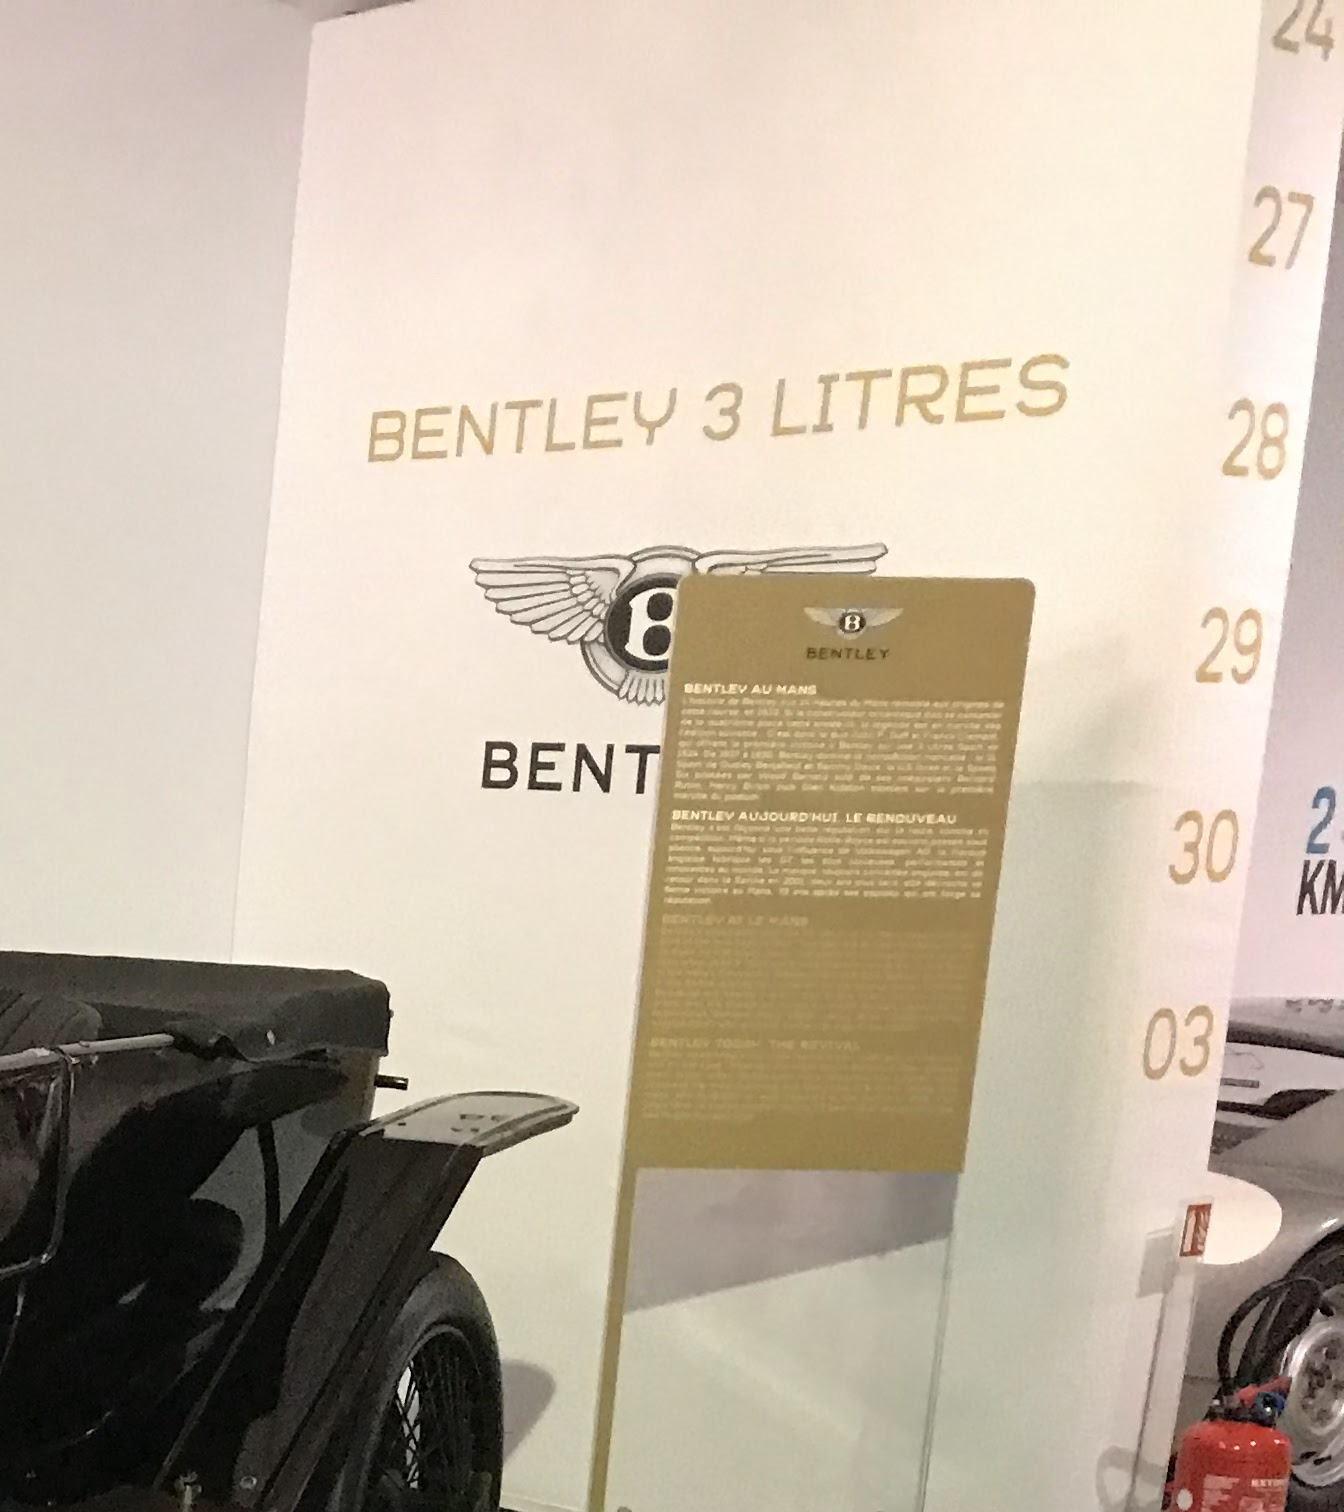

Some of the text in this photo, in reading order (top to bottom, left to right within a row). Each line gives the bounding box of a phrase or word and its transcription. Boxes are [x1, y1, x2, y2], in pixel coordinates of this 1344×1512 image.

[1272, 0, 1334, 61] 24
[1248, 185, 1316, 270] 27
[367, 353, 1071, 463] BENTLEY 3 LITRES
[1222, 397, 1289, 481] 28
[806, 646, 891, 661] BENTLEY
[1195, 606, 1263, 685] 29
[683, 682, 818, 696] BENTLEY AU MANS
[481, 740, 661, 795] BENT
[672, 809, 736, 822] BENTLEY
[846, 812, 863, 824] LE
[866, 812, 958, 825] RENOUVEAU
[1168, 808, 1240, 885] 30
[1143, 1004, 1215, 1081] 03
